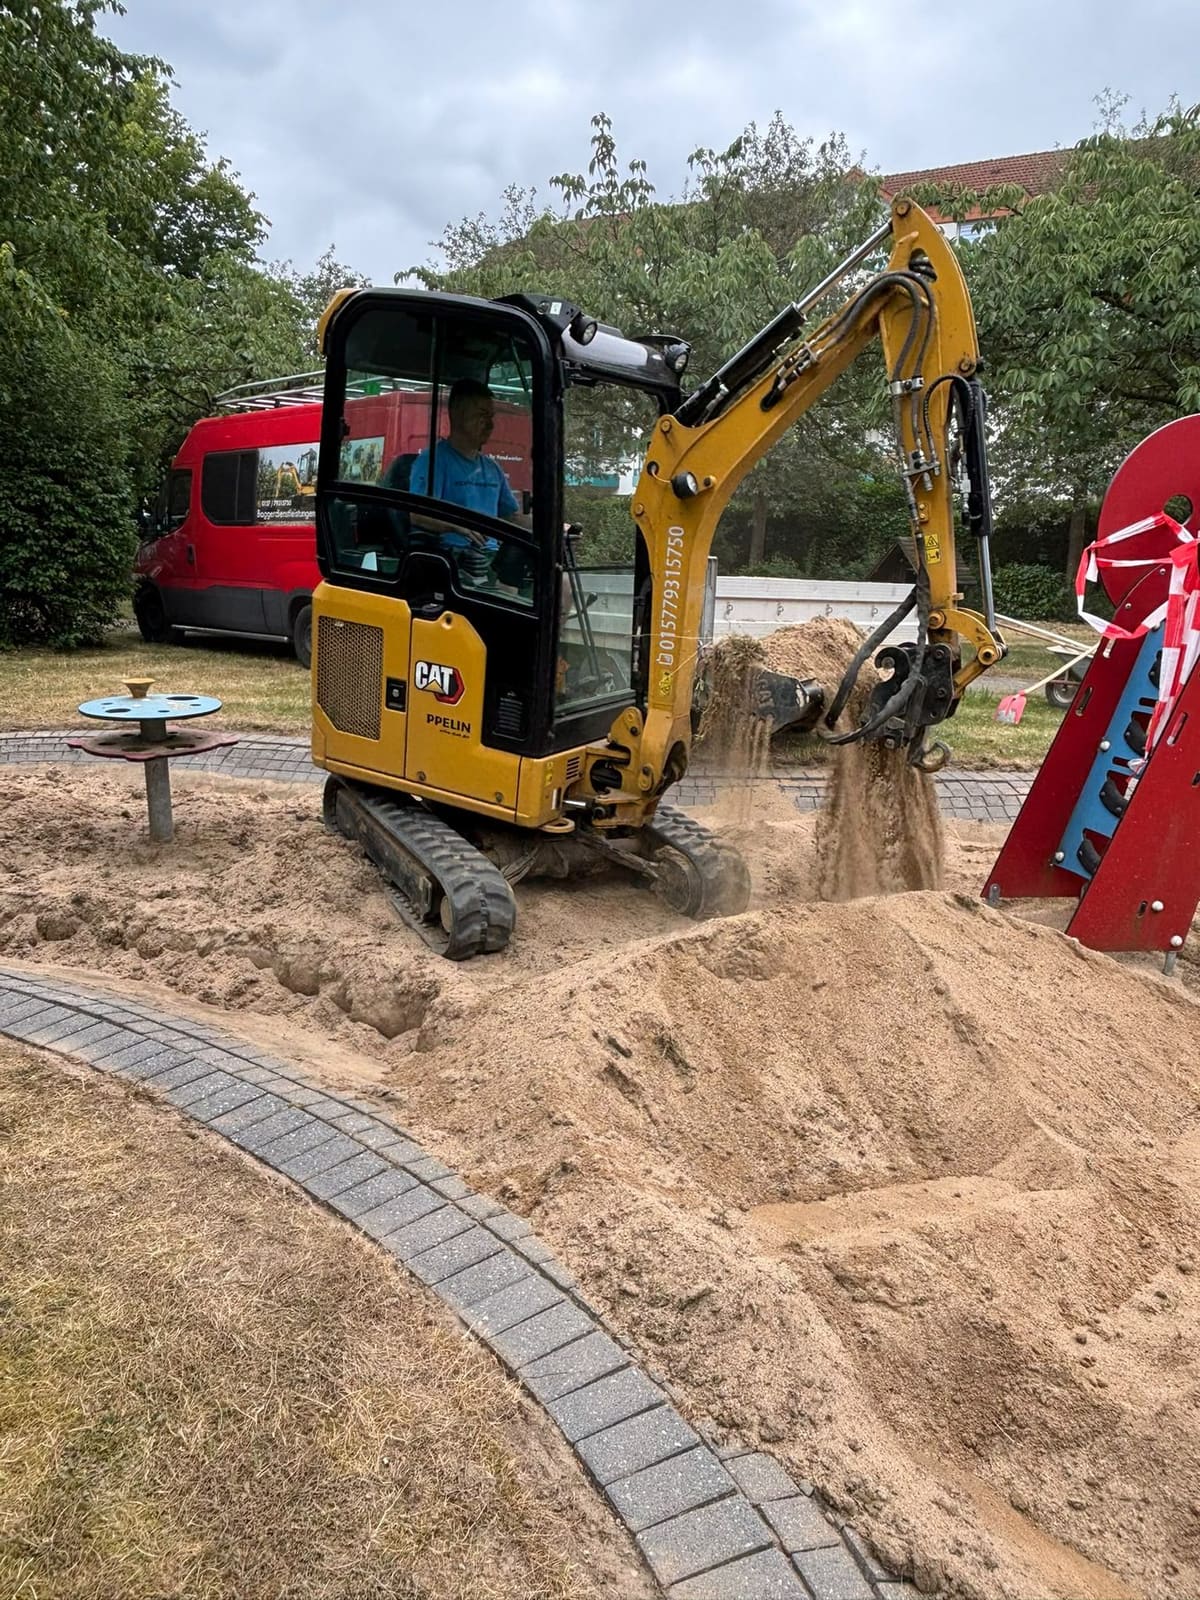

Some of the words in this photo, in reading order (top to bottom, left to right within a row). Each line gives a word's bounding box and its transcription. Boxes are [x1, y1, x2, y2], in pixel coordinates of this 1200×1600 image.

[659, 526, 685, 647] 015779315750
[415, 661, 454, 696] CAT
[426, 713, 471, 734] PPELIN
